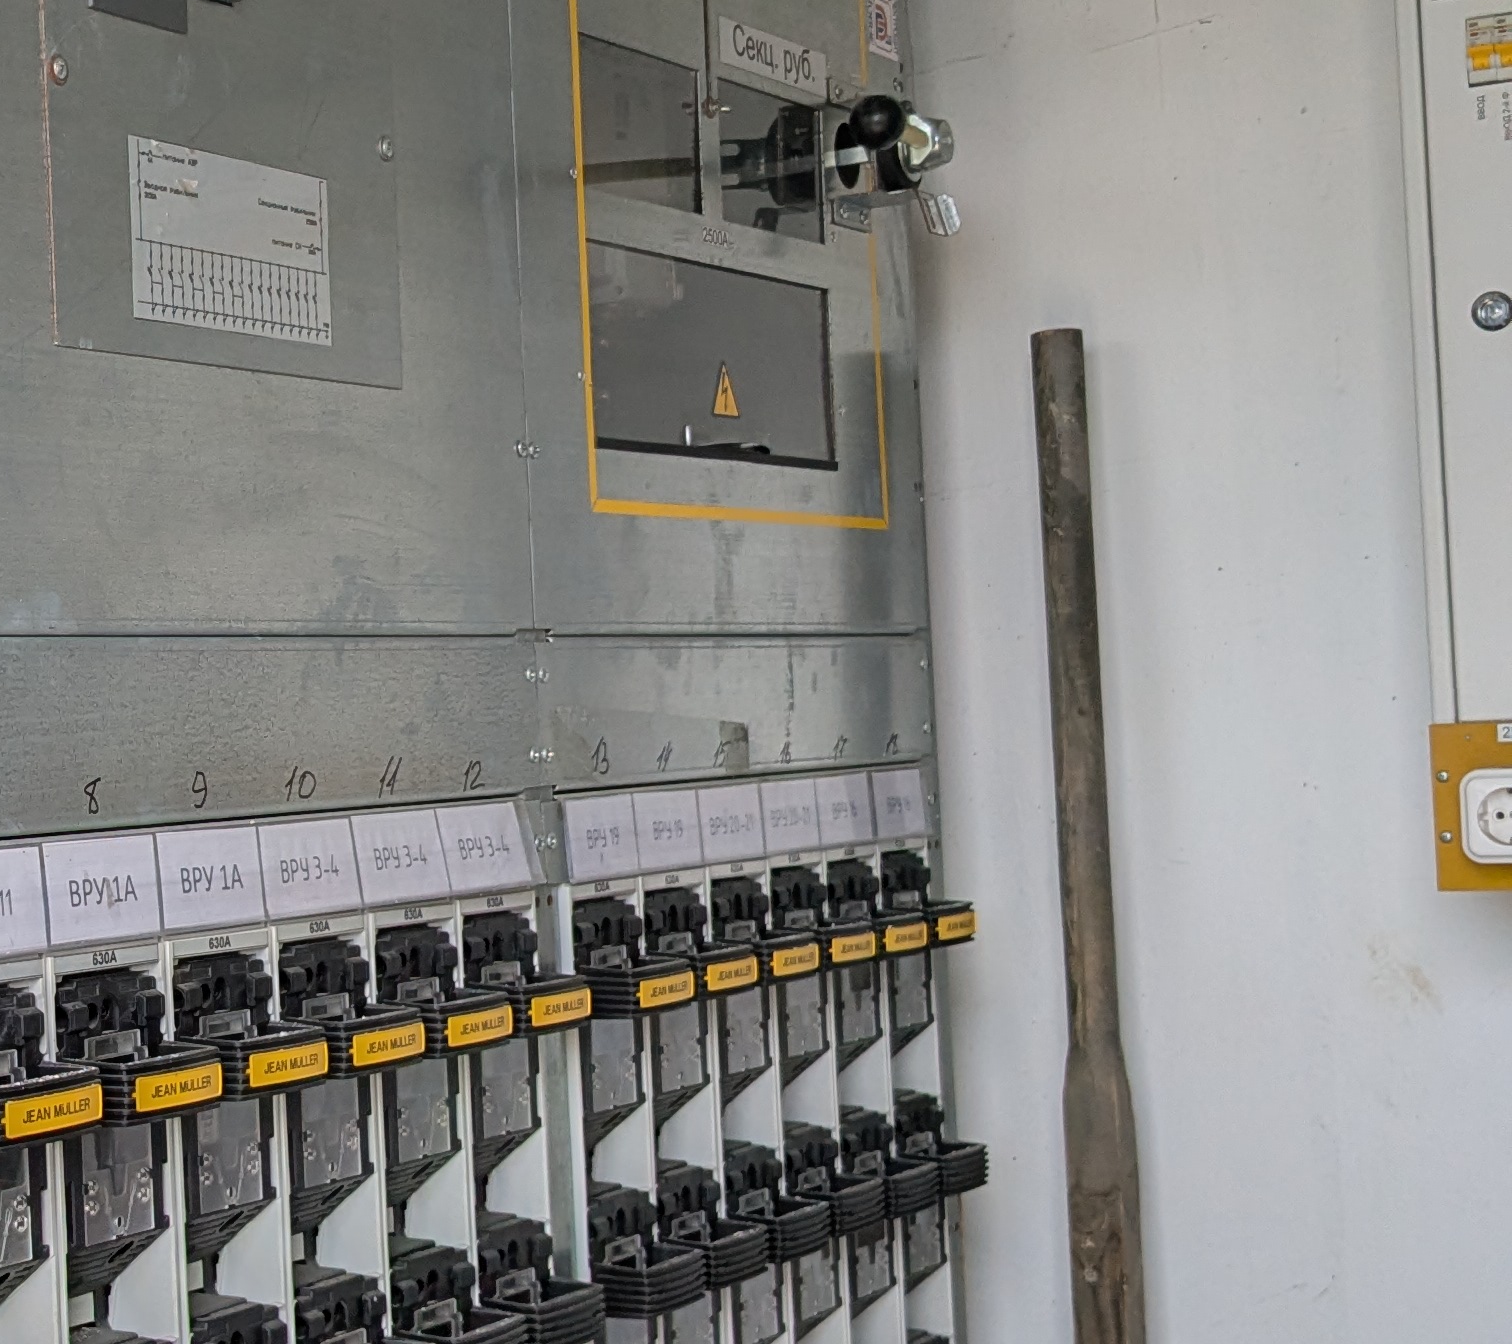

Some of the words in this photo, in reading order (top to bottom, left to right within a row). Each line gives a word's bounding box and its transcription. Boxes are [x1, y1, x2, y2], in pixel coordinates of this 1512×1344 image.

[732, 24, 778, 74] Секц.
[783, 48, 815, 84] руб.
[591, 736, 610, 775] 13
[285, 765, 317, 801] 10
[462, 759, 486, 792] 12
[84, 777, 102, 815] 8
[191, 771, 208, 808] 9
[373, 847, 401, 871] ВРУ
[404, 844, 428, 868] 3-4
[457, 836, 484, 861] ВРУ
[484, 835, 510, 857] 3-4
[180, 865, 214, 894] ВРУ
[280, 858, 310, 884] ВРУ
[313, 854, 339, 880] 3-4
[68, 877, 107, 908] ВРУ
[309, 920, 330, 933] 630A
[209, 935, 232, 949] 630A
[92, 951, 118, 966] 630A
[543, 1004, 561, 1016] JEAN
[460, 1024, 480, 1035] JEAN
[366, 1042, 388, 1054] JEAN
[264, 1059, 287, 1074] JEAN
[151, 1083, 177, 1099] JEAN
[22, 1106, 51, 1124] JEAN
